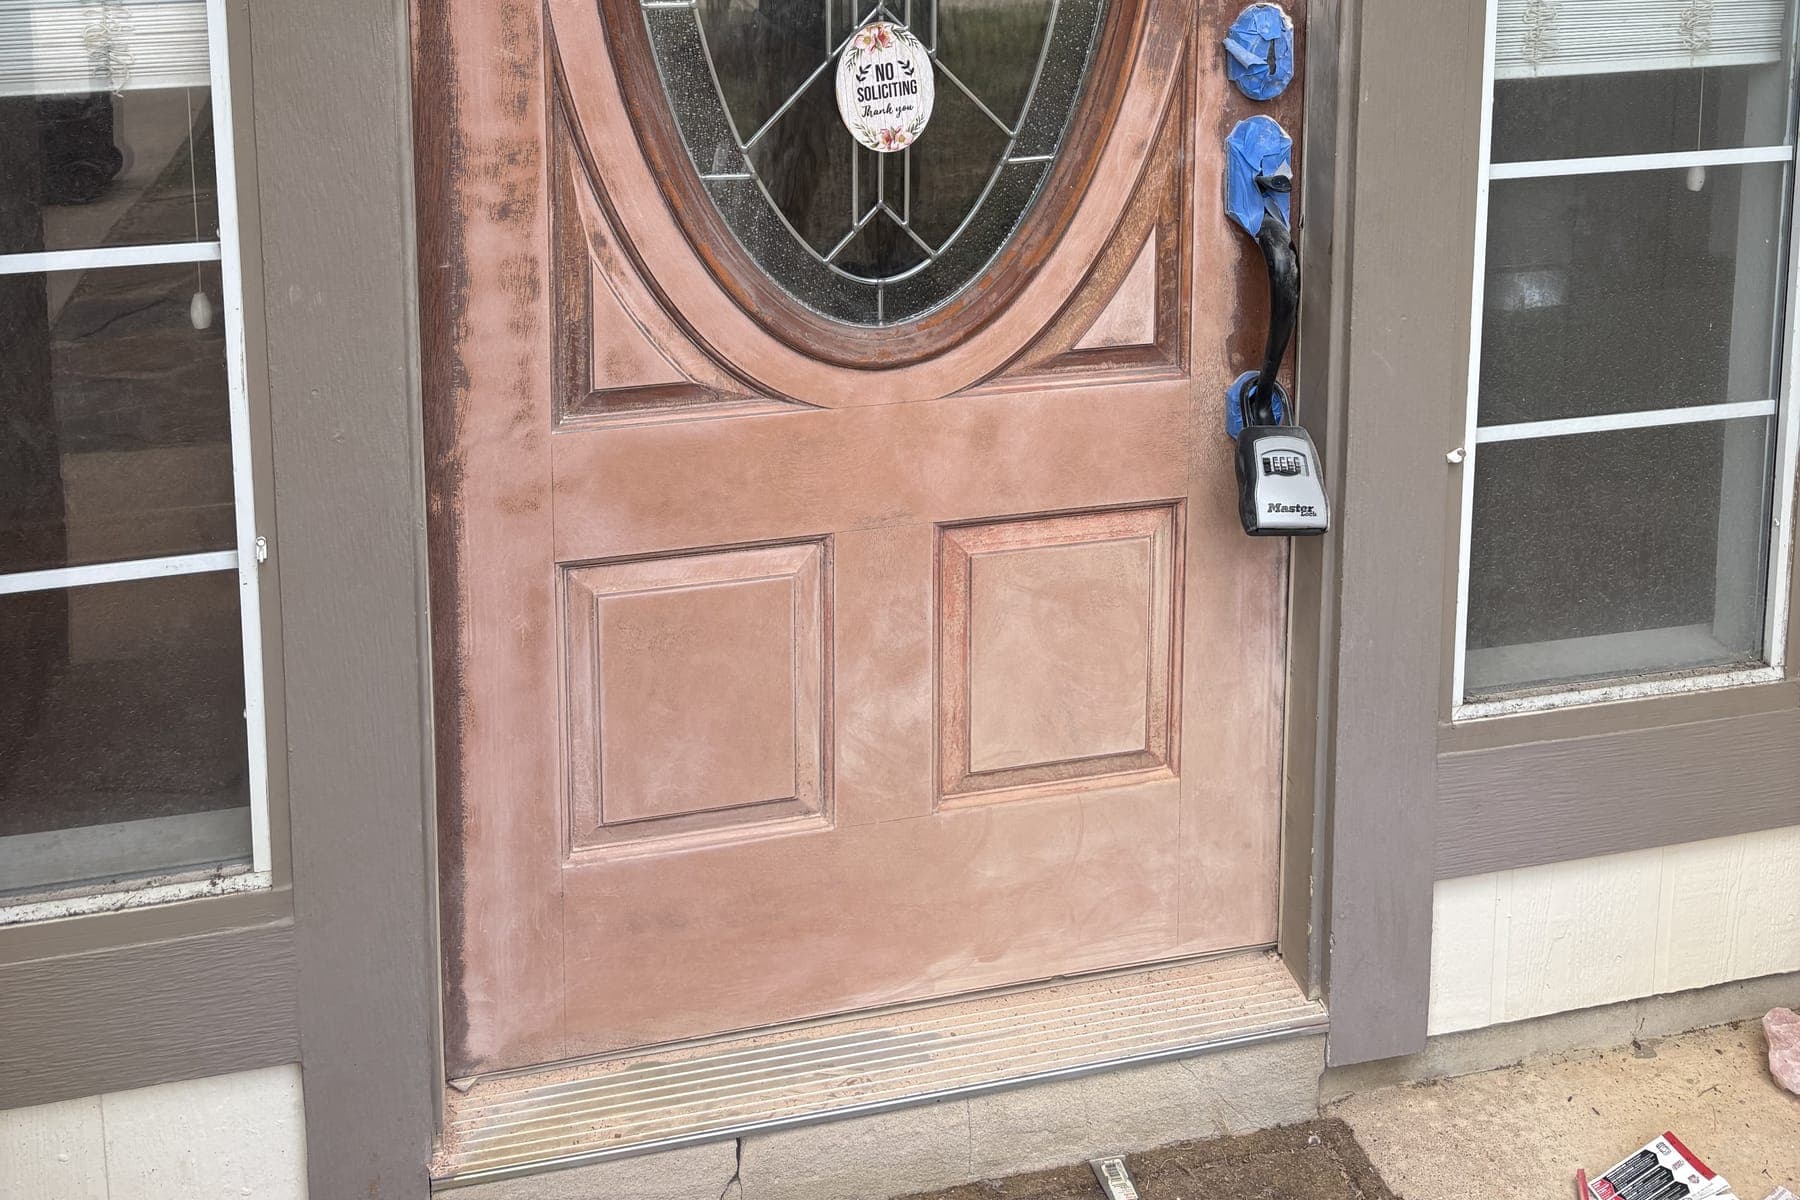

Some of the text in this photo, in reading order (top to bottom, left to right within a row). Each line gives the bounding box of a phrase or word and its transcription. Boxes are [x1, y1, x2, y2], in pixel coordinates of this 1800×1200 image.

[875, 62, 894, 81] NO
[857, 79, 917, 102] SOLICITING
[861, 103, 914, 118] Thank you
[1267, 503, 1314, 512] Master
